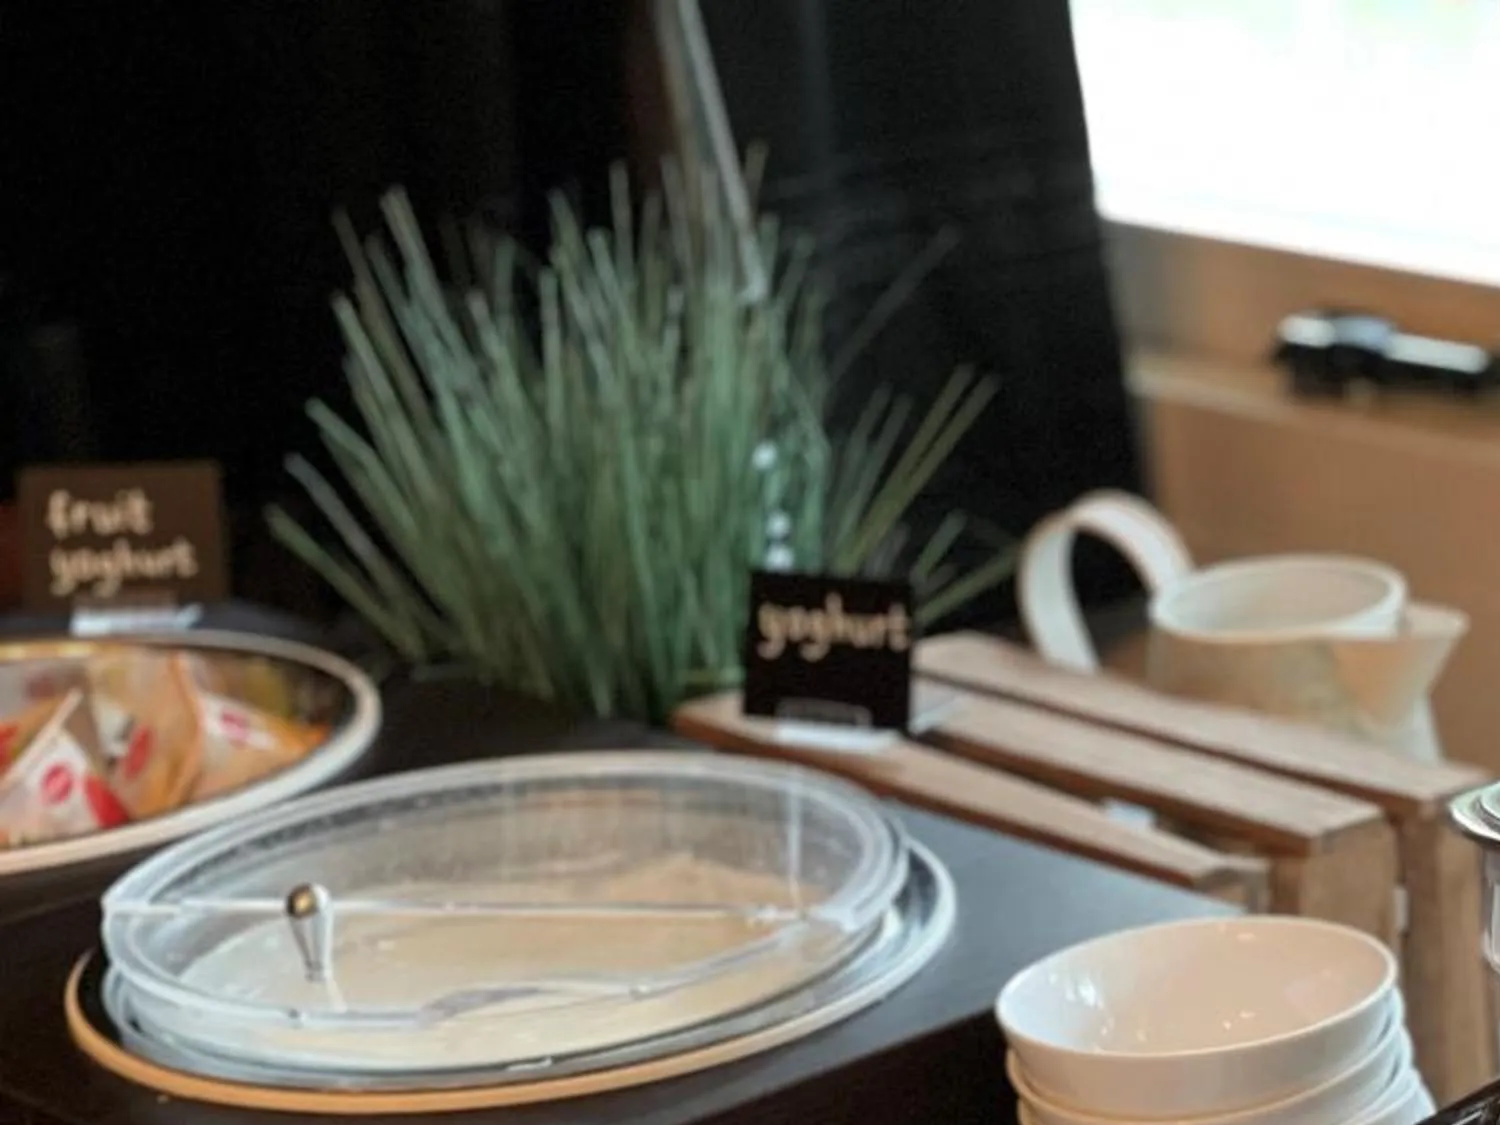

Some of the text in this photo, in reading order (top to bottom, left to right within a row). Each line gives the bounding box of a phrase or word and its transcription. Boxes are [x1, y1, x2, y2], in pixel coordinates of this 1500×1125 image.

[48, 488, 152, 538] fruit
[50, 537, 198, 597] yoghurt
[757, 591, 910, 663] yoghurt
